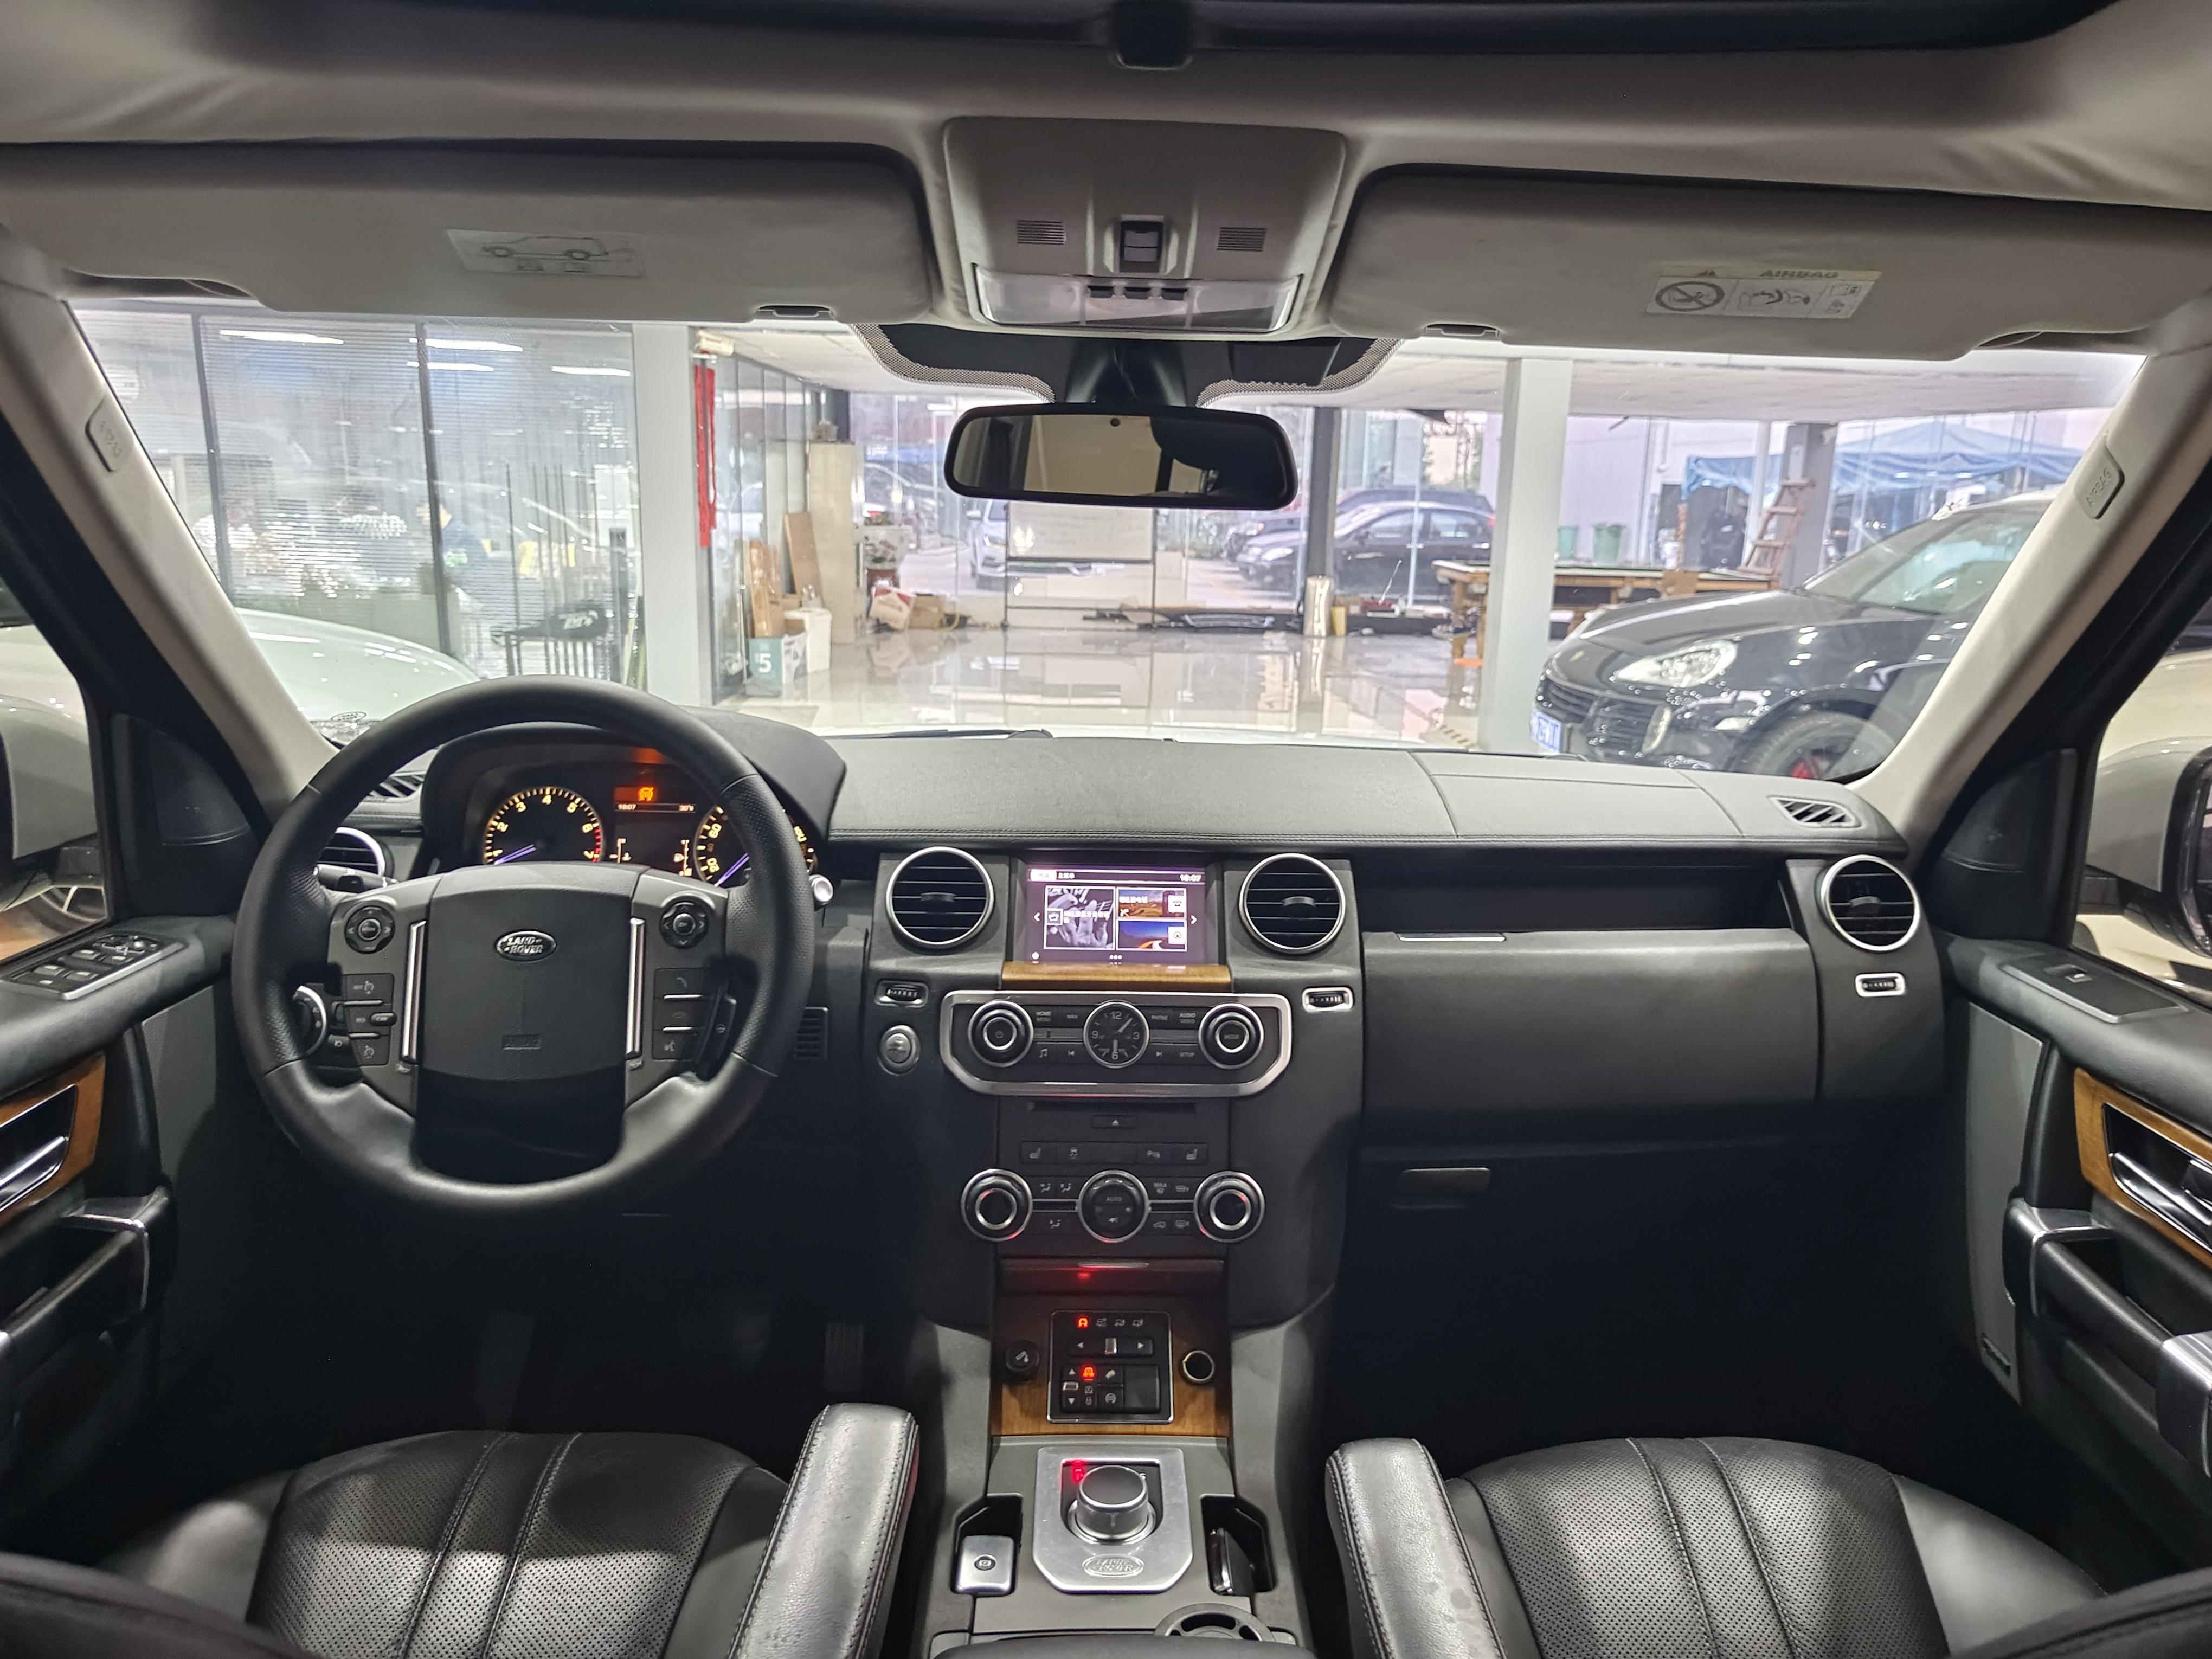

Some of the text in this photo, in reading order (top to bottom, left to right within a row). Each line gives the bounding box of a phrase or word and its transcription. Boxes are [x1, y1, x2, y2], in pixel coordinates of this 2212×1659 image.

[1760, 270, 1838, 278] AIRBAG
[2086, 467, 2112, 507] AIRBAG
[758, 652, 773, 674] 5
[542, 795, 551, 805] 4
[516, 801, 526, 812] 3
[567, 802, 578, 813] 5
[497, 821, 509, 832] 2
[582, 822, 594, 833] 6
[708, 823, 722, 839] 60
[493, 849, 503, 857] 1
[583, 850, 595, 859] 7
[707, 857, 721, 873] 20
[507, 936, 537, 946] LAND
[509, 944, 543, 954] ROVER
[1109, 1011, 1123, 1020] 12
[1091, 1030, 1099, 1039] 9
[1133, 1031, 1140, 1040] 3
[1111, 1051, 1118, 1060] 6
